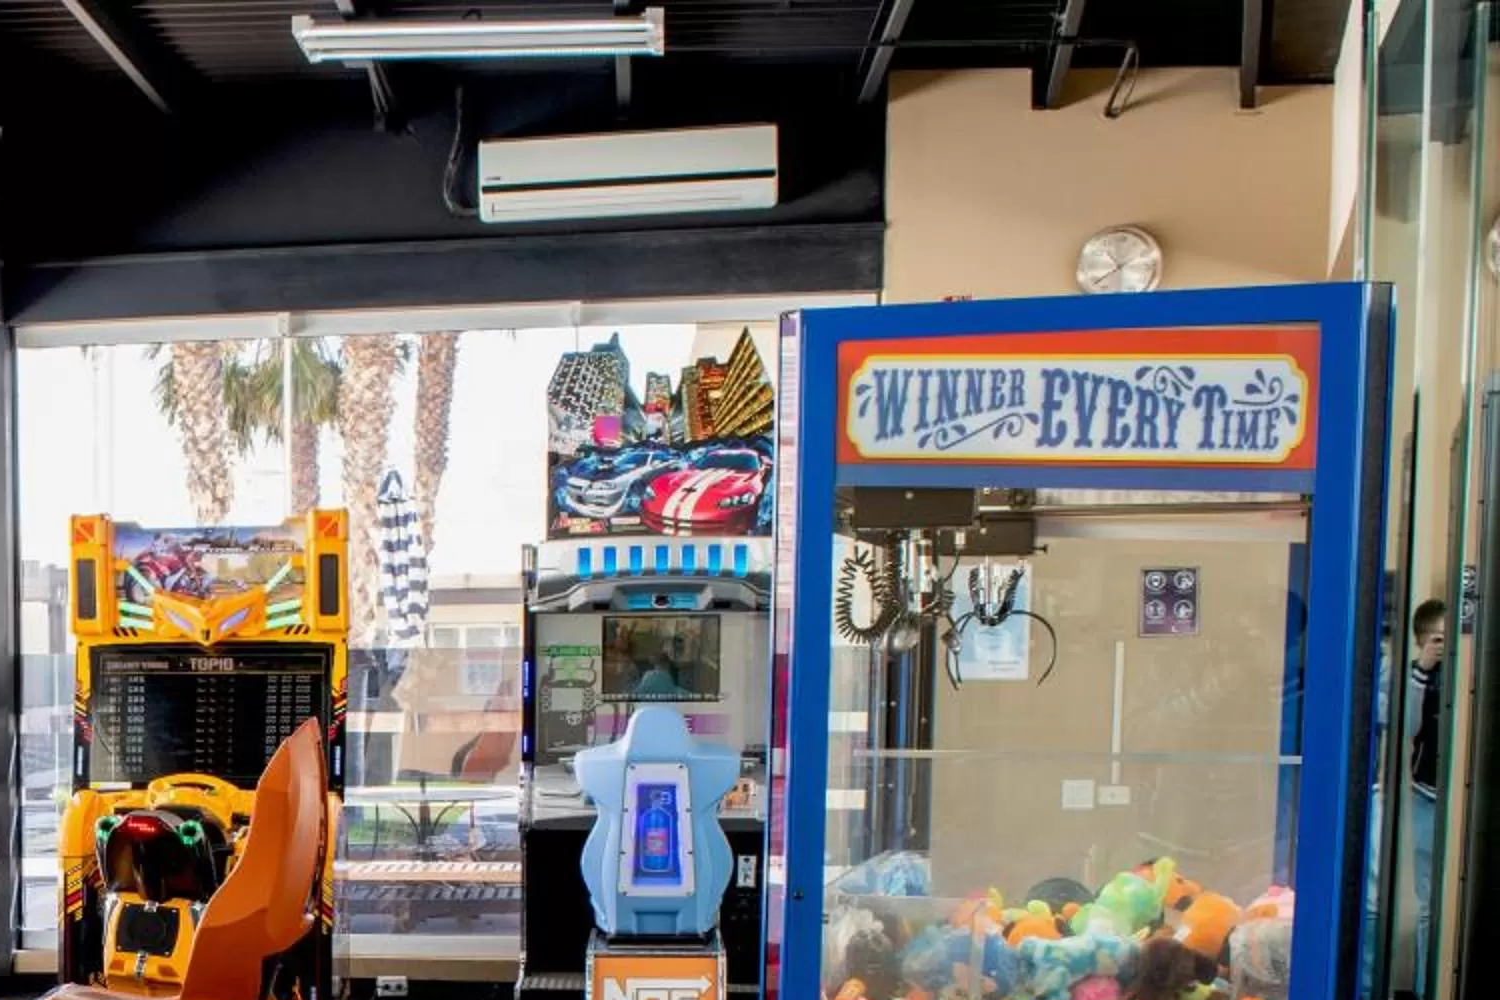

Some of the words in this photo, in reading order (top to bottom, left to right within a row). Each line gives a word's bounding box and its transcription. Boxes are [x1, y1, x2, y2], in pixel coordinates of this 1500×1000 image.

[872, 367, 1026, 442] WINNER
[1035, 366, 1187, 450] EVERY
[1193, 384, 1282, 451] TIME
